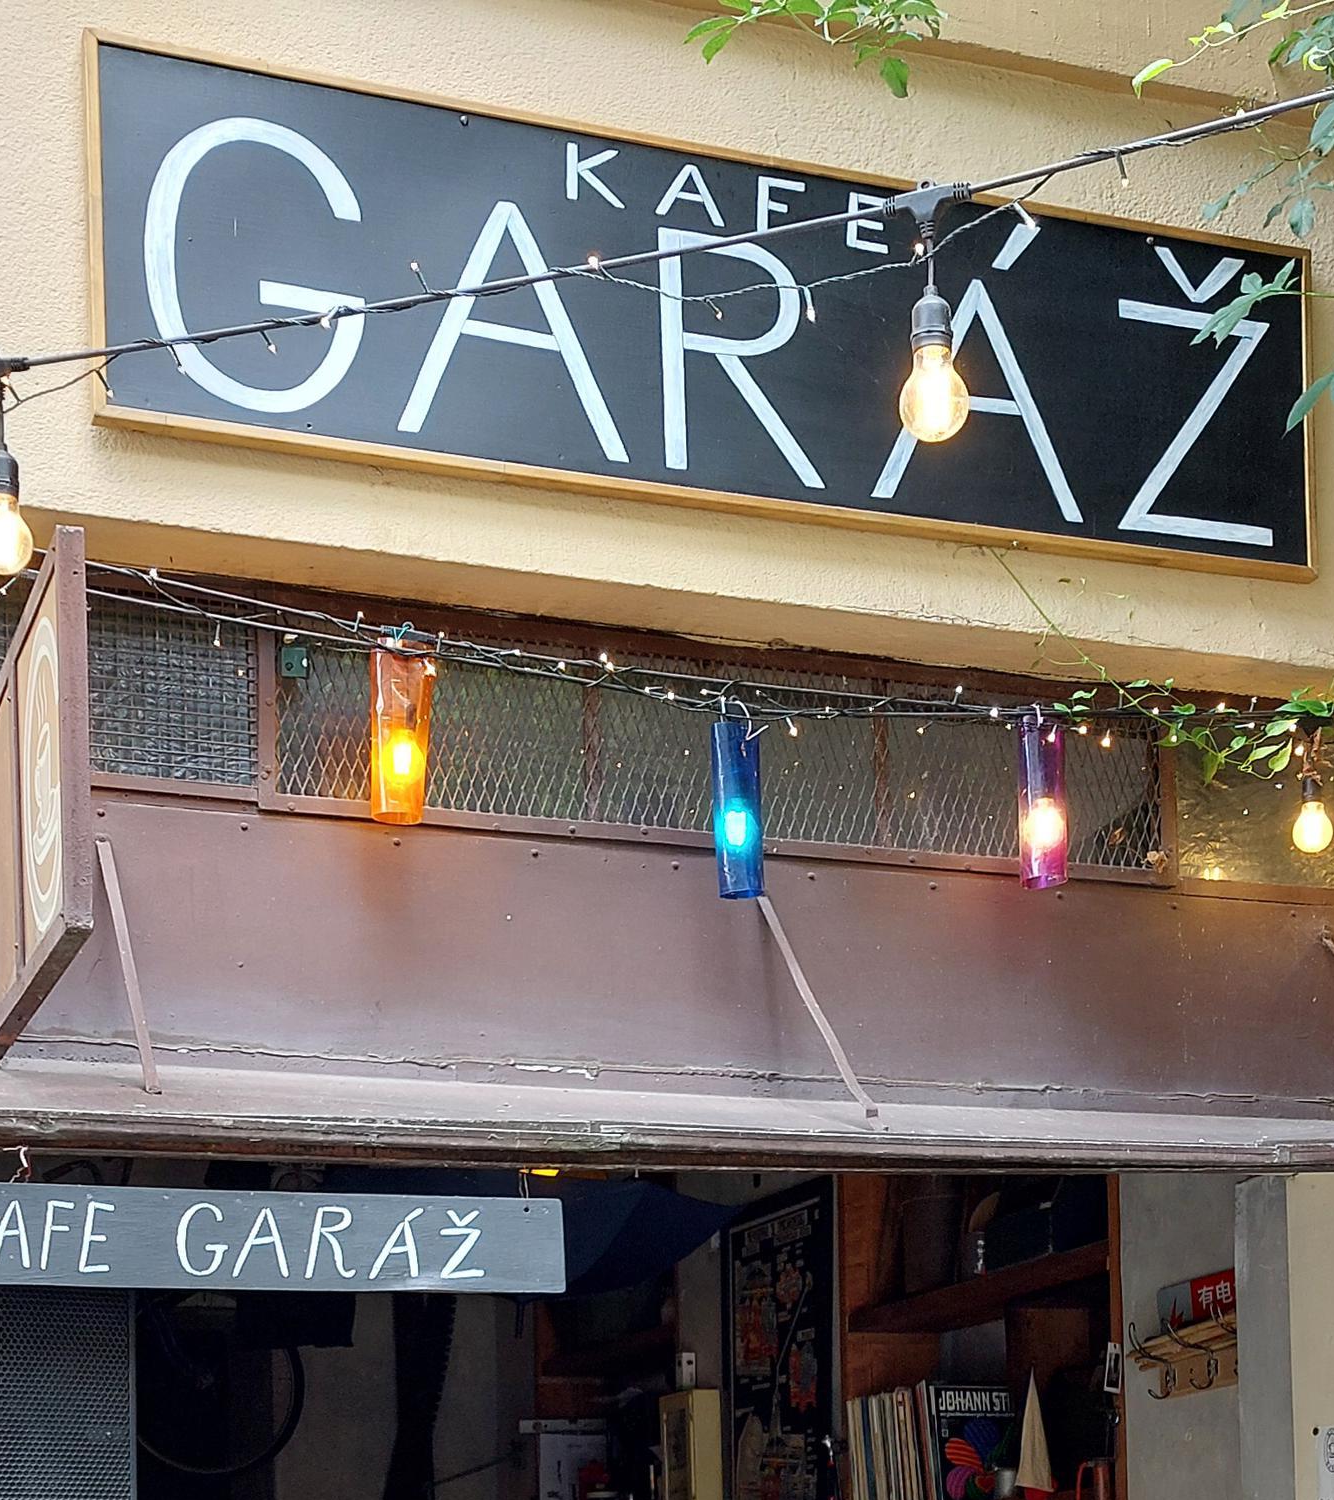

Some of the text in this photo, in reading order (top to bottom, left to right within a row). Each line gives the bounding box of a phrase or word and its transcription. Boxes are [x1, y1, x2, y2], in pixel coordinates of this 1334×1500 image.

[565, 140, 891, 256] KAFE
[143, 117, 1274, 547] GARÁŽ
[175, 1201, 486, 1281] GARÁŽ
[1197, 1279, 1235, 1311] 有电
[938, 1390, 991, 1412] JOHANN
